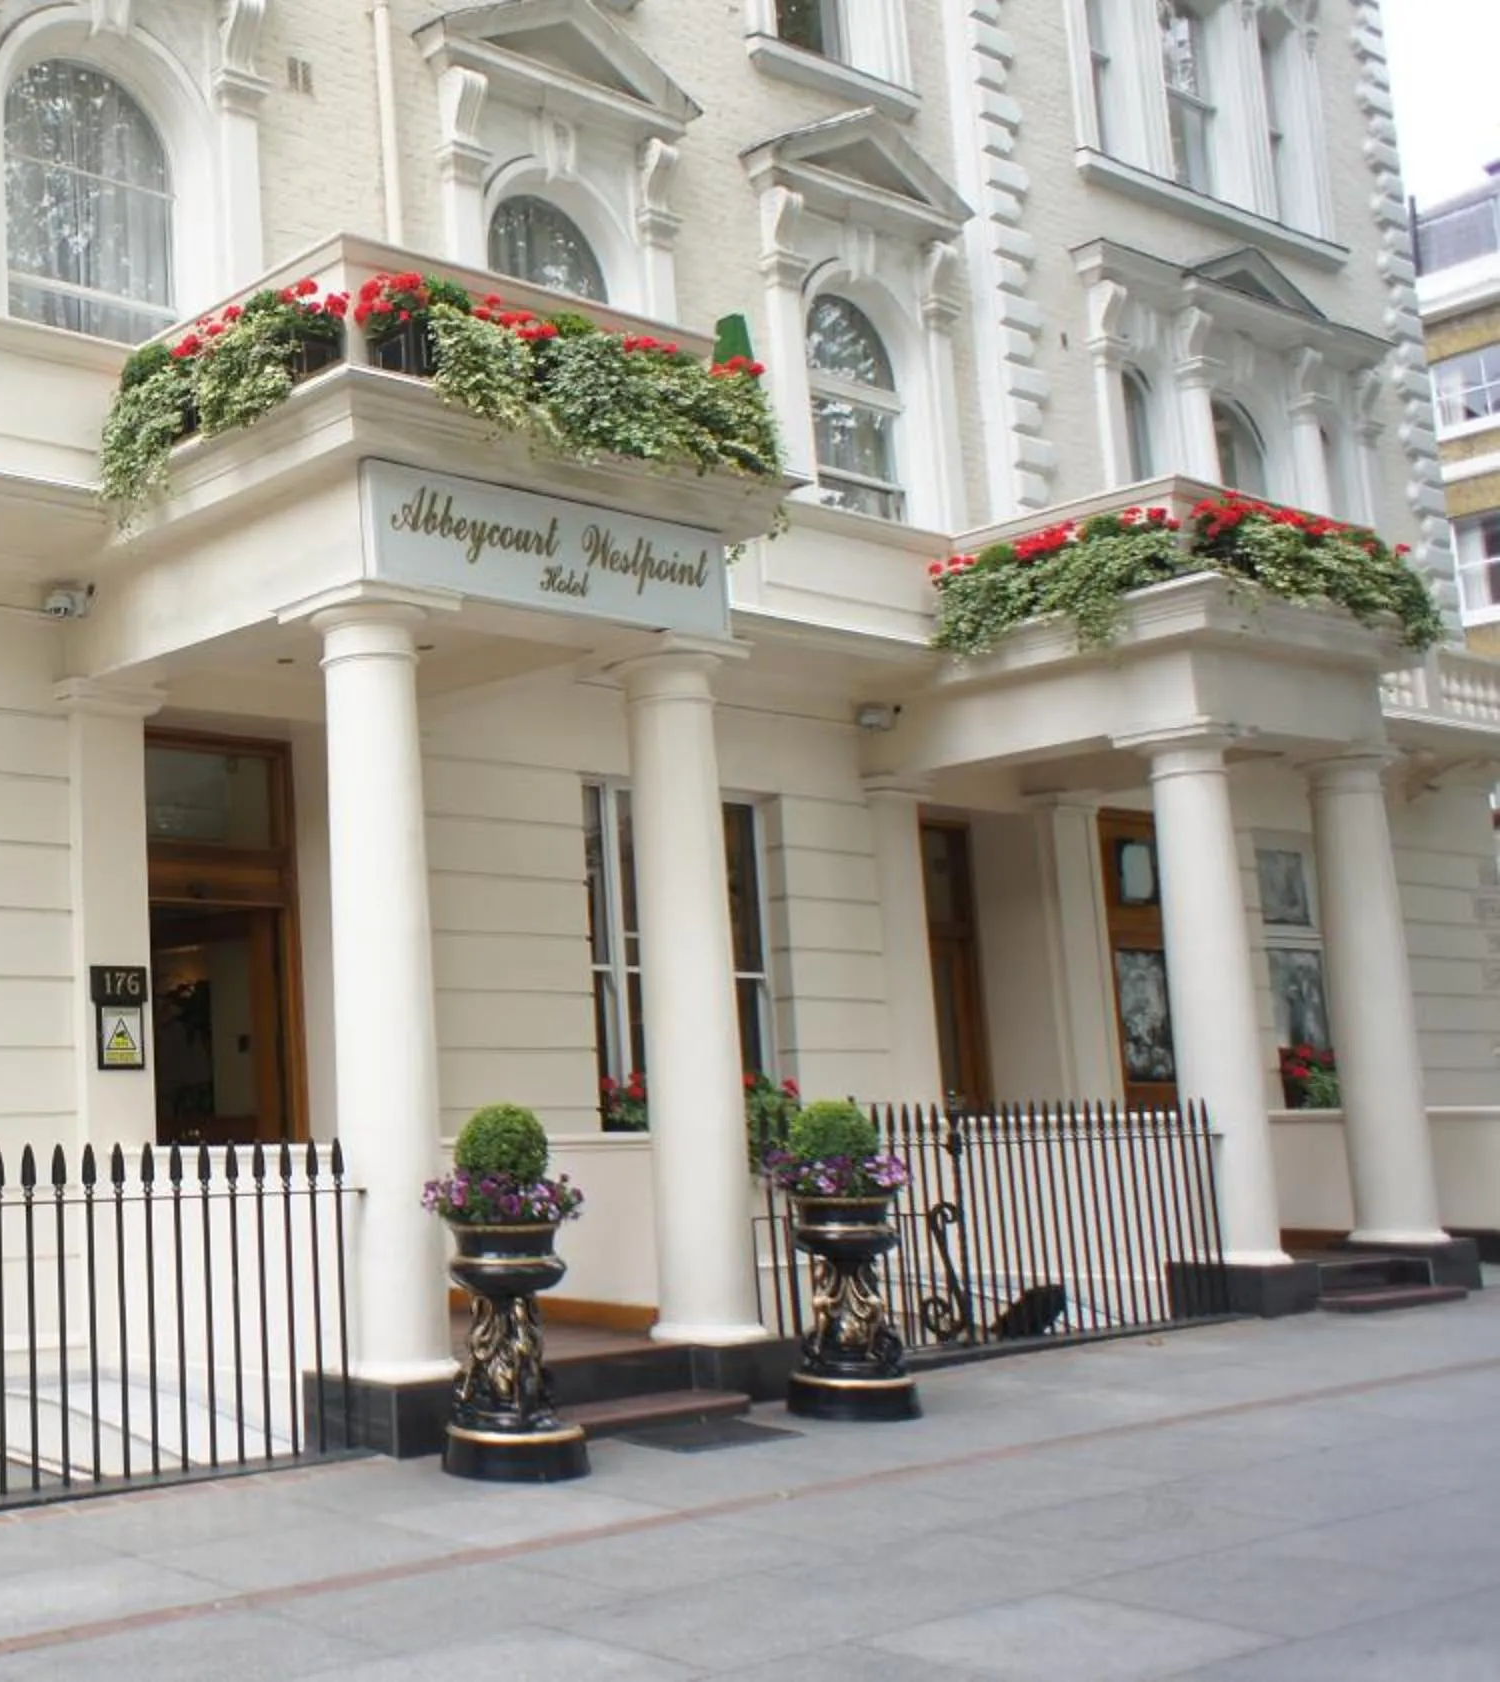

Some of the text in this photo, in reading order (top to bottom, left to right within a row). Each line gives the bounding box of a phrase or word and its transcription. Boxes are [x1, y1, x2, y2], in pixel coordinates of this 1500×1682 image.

[391, 486, 709, 596] Abbeycourt Westpoint
[539, 566, 591, 598] Hotel
[104, 971, 140, 995] 176
